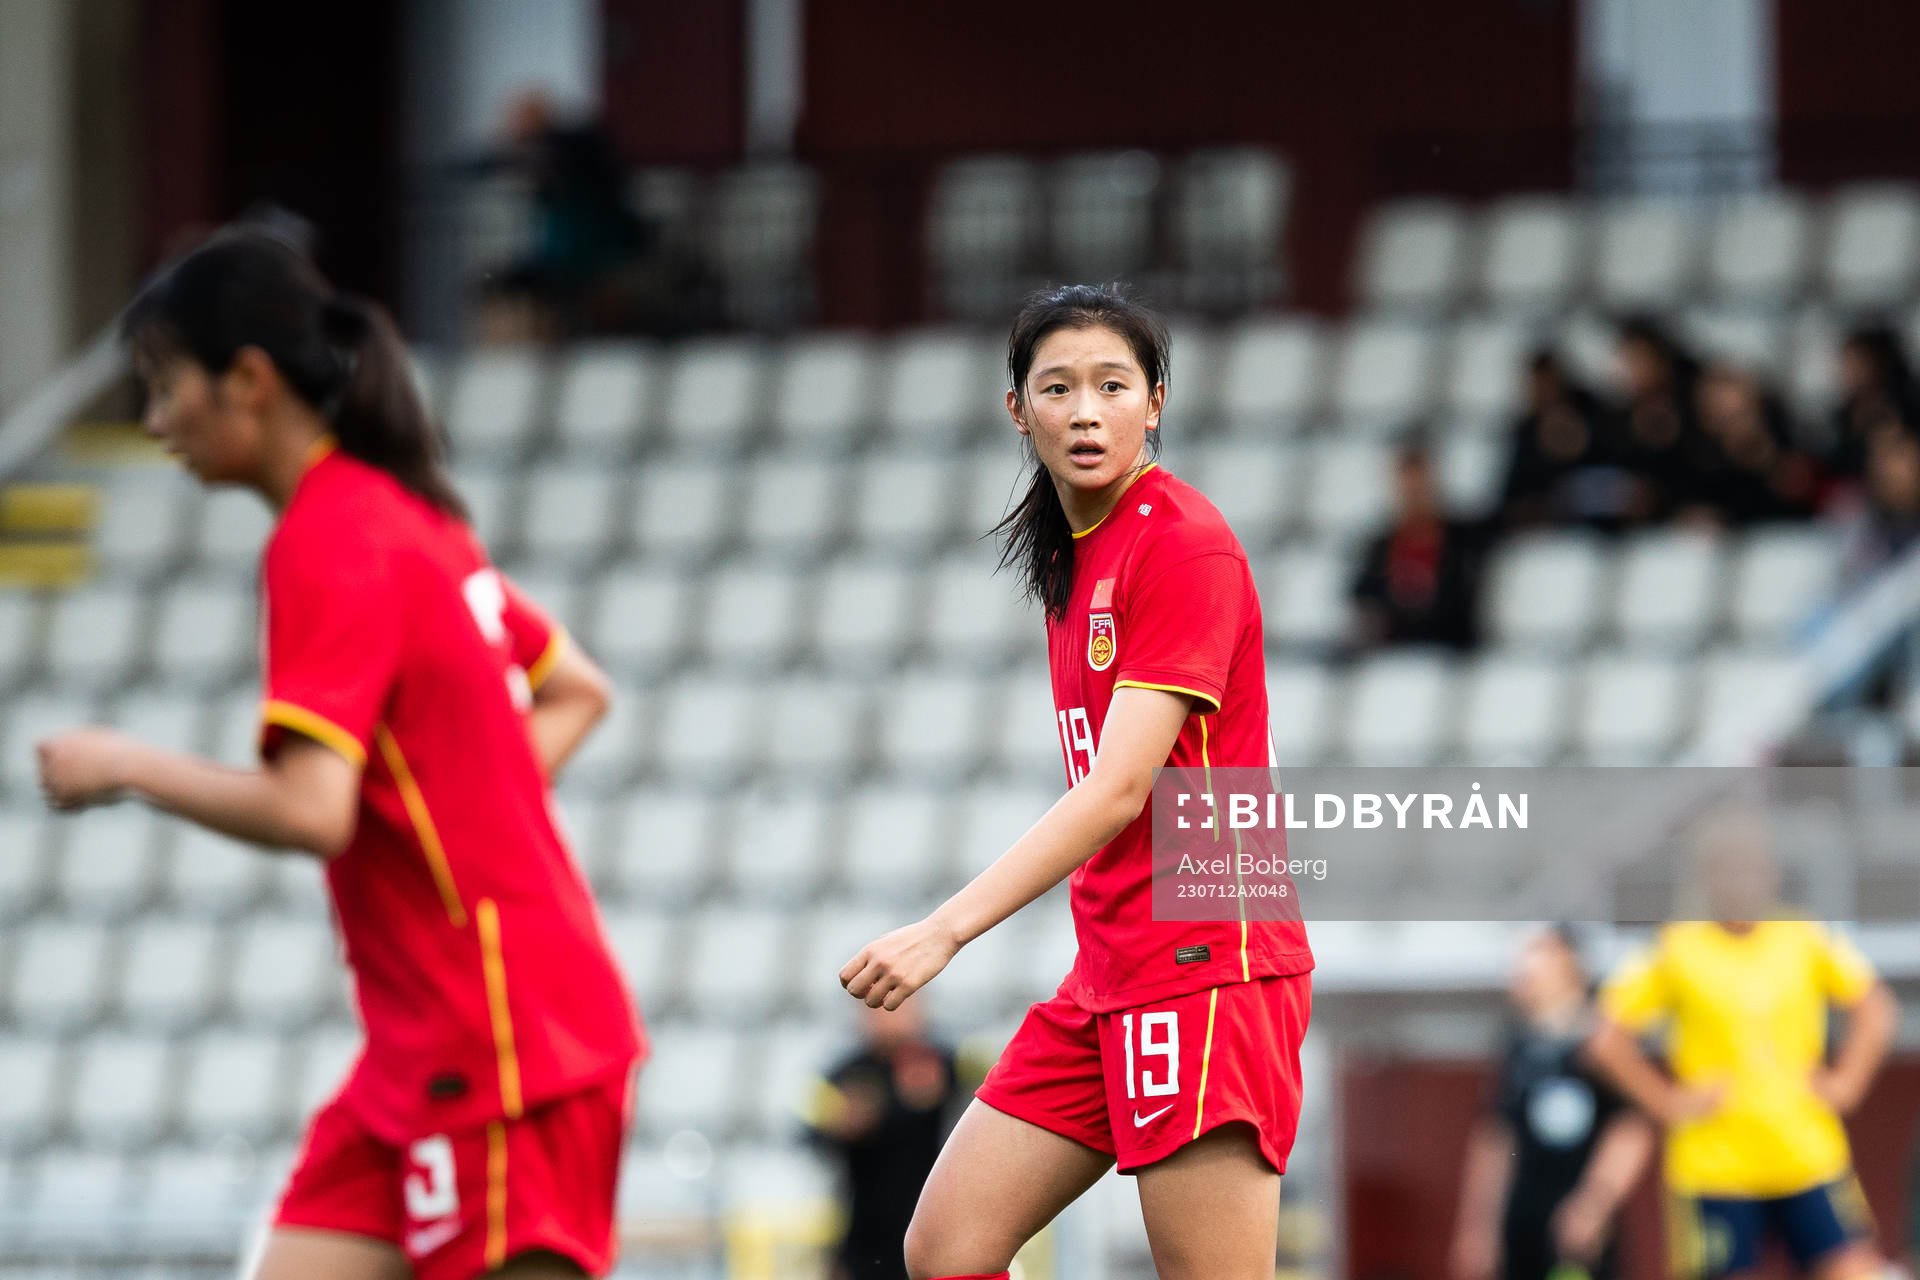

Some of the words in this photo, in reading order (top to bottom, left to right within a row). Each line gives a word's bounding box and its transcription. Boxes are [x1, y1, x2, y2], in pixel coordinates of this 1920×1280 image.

[1093, 619, 1111, 629] CFA
[1059, 707, 1097, 786] 19
[1123, 1011, 1180, 1099] 19
